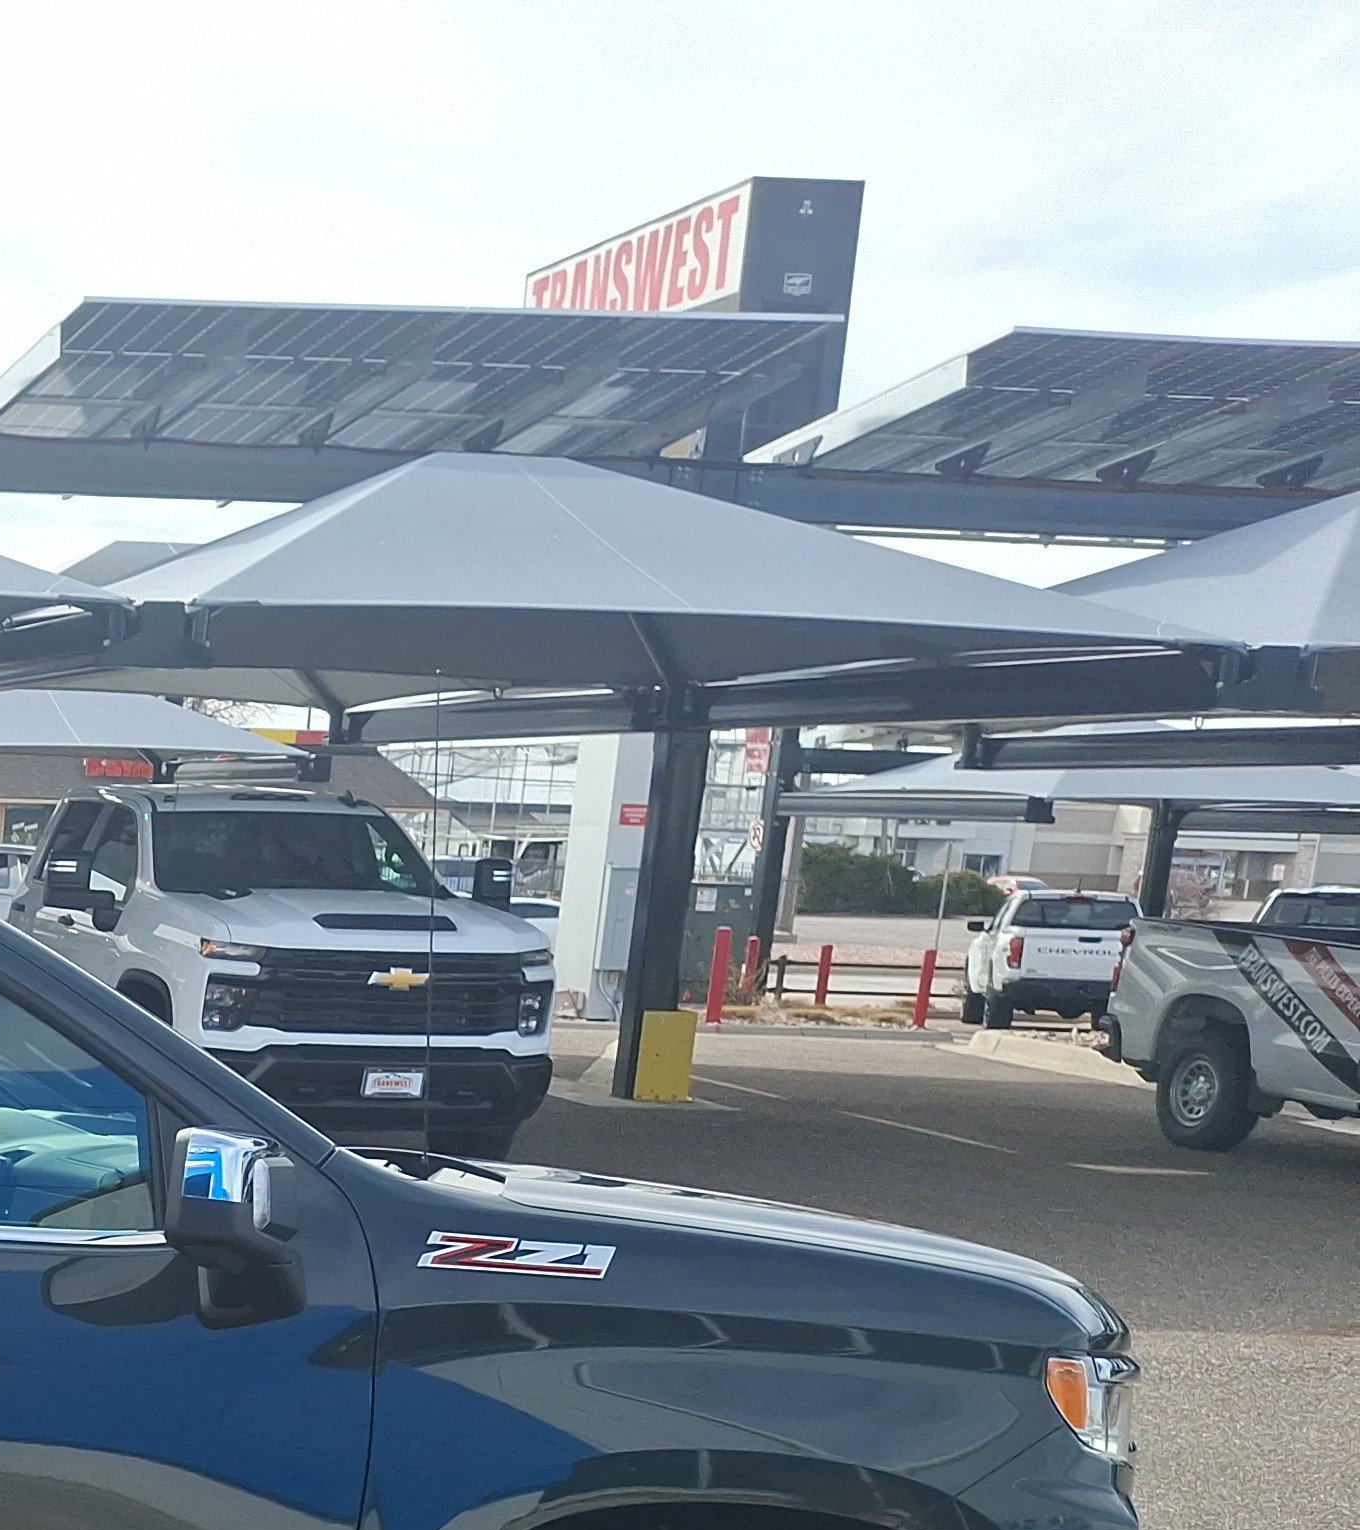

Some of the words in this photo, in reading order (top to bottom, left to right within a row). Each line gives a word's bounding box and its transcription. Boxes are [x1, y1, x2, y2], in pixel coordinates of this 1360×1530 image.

[1037, 946, 1118, 956] CHEVROL
[1237, 942, 1332, 1054] TRANSWEST.COM
[416, 1230, 617, 1280] Z71
